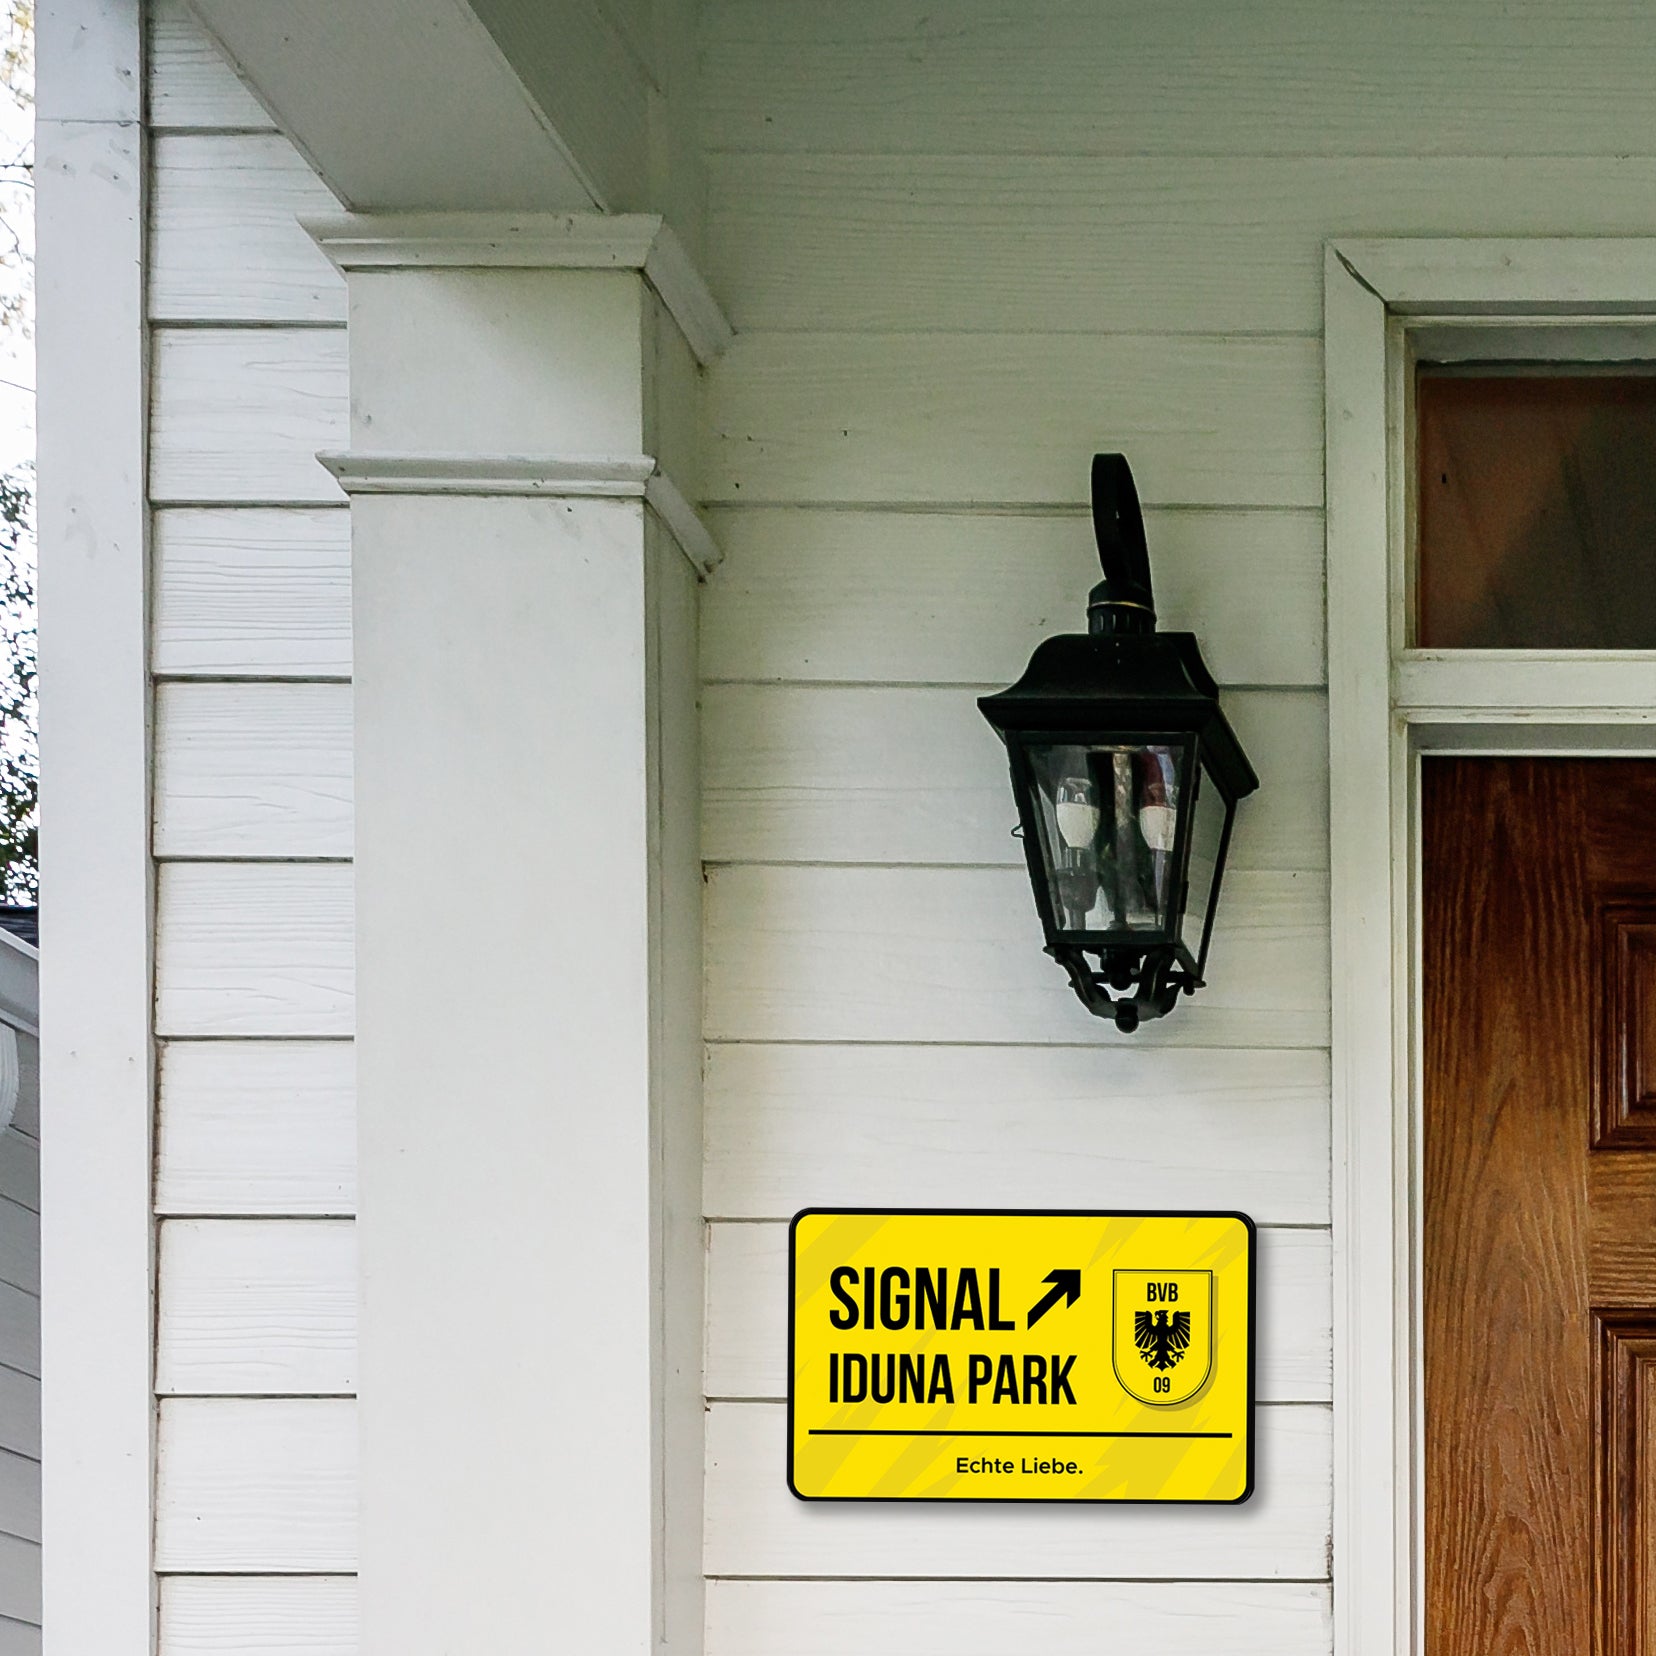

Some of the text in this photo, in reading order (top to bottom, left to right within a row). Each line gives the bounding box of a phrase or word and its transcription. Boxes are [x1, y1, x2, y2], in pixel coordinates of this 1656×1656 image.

[829, 1266, 1016, 1331] SIGNAL
[1146, 1282, 1179, 1302] BVB
[829, 1353, 1078, 1405] IDUNA PARK
[1153, 1376, 1171, 1394] 09
[956, 1457, 1084, 1475] Echte Liebe.
